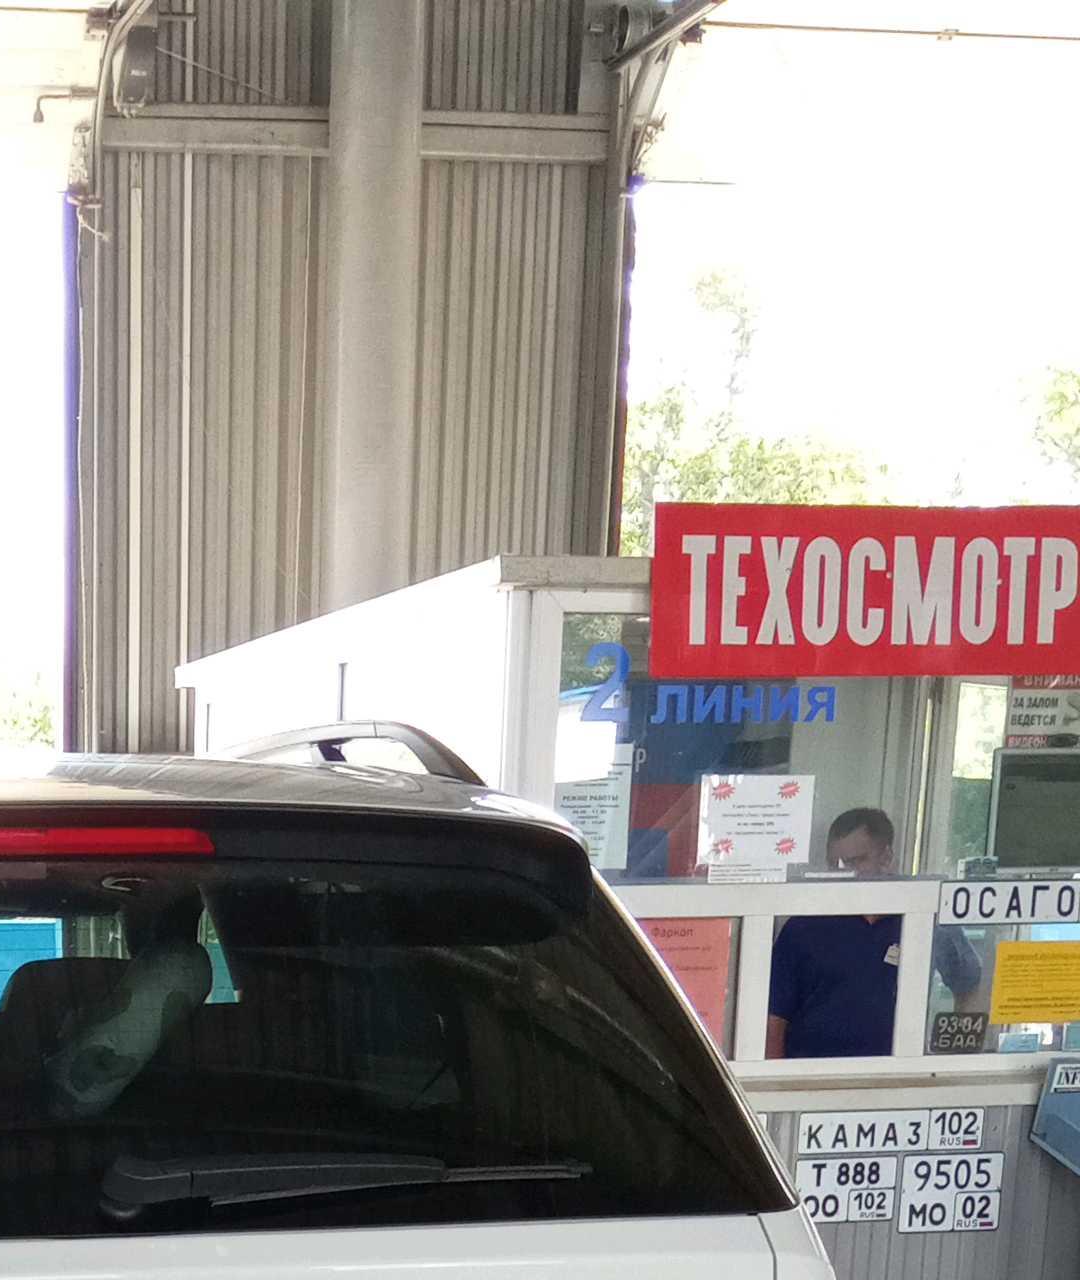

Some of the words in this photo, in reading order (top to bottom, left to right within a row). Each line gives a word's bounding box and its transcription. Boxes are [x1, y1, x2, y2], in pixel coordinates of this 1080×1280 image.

[682, 535, 1079, 646] ТЕХОСМОТР
[581, 642, 631, 724] 2
[650, 684, 837, 724] ЛИНИЯ
[952, 885, 1075, 919] ОСАГО
[934, 1111, 978, 1137] 102
[939, 1138, 962, 1146] RUS
[812, 1163, 827, 1187] Т
[837, 1161, 881, 1186] 888
[914, 1158, 992, 1191] 9505
[854, 1192, 887, 1211] 102
[908, 1203, 946, 1227] МО
[962, 1195, 990, 1218] 02
[956, 1220, 978, 1228] RUS
